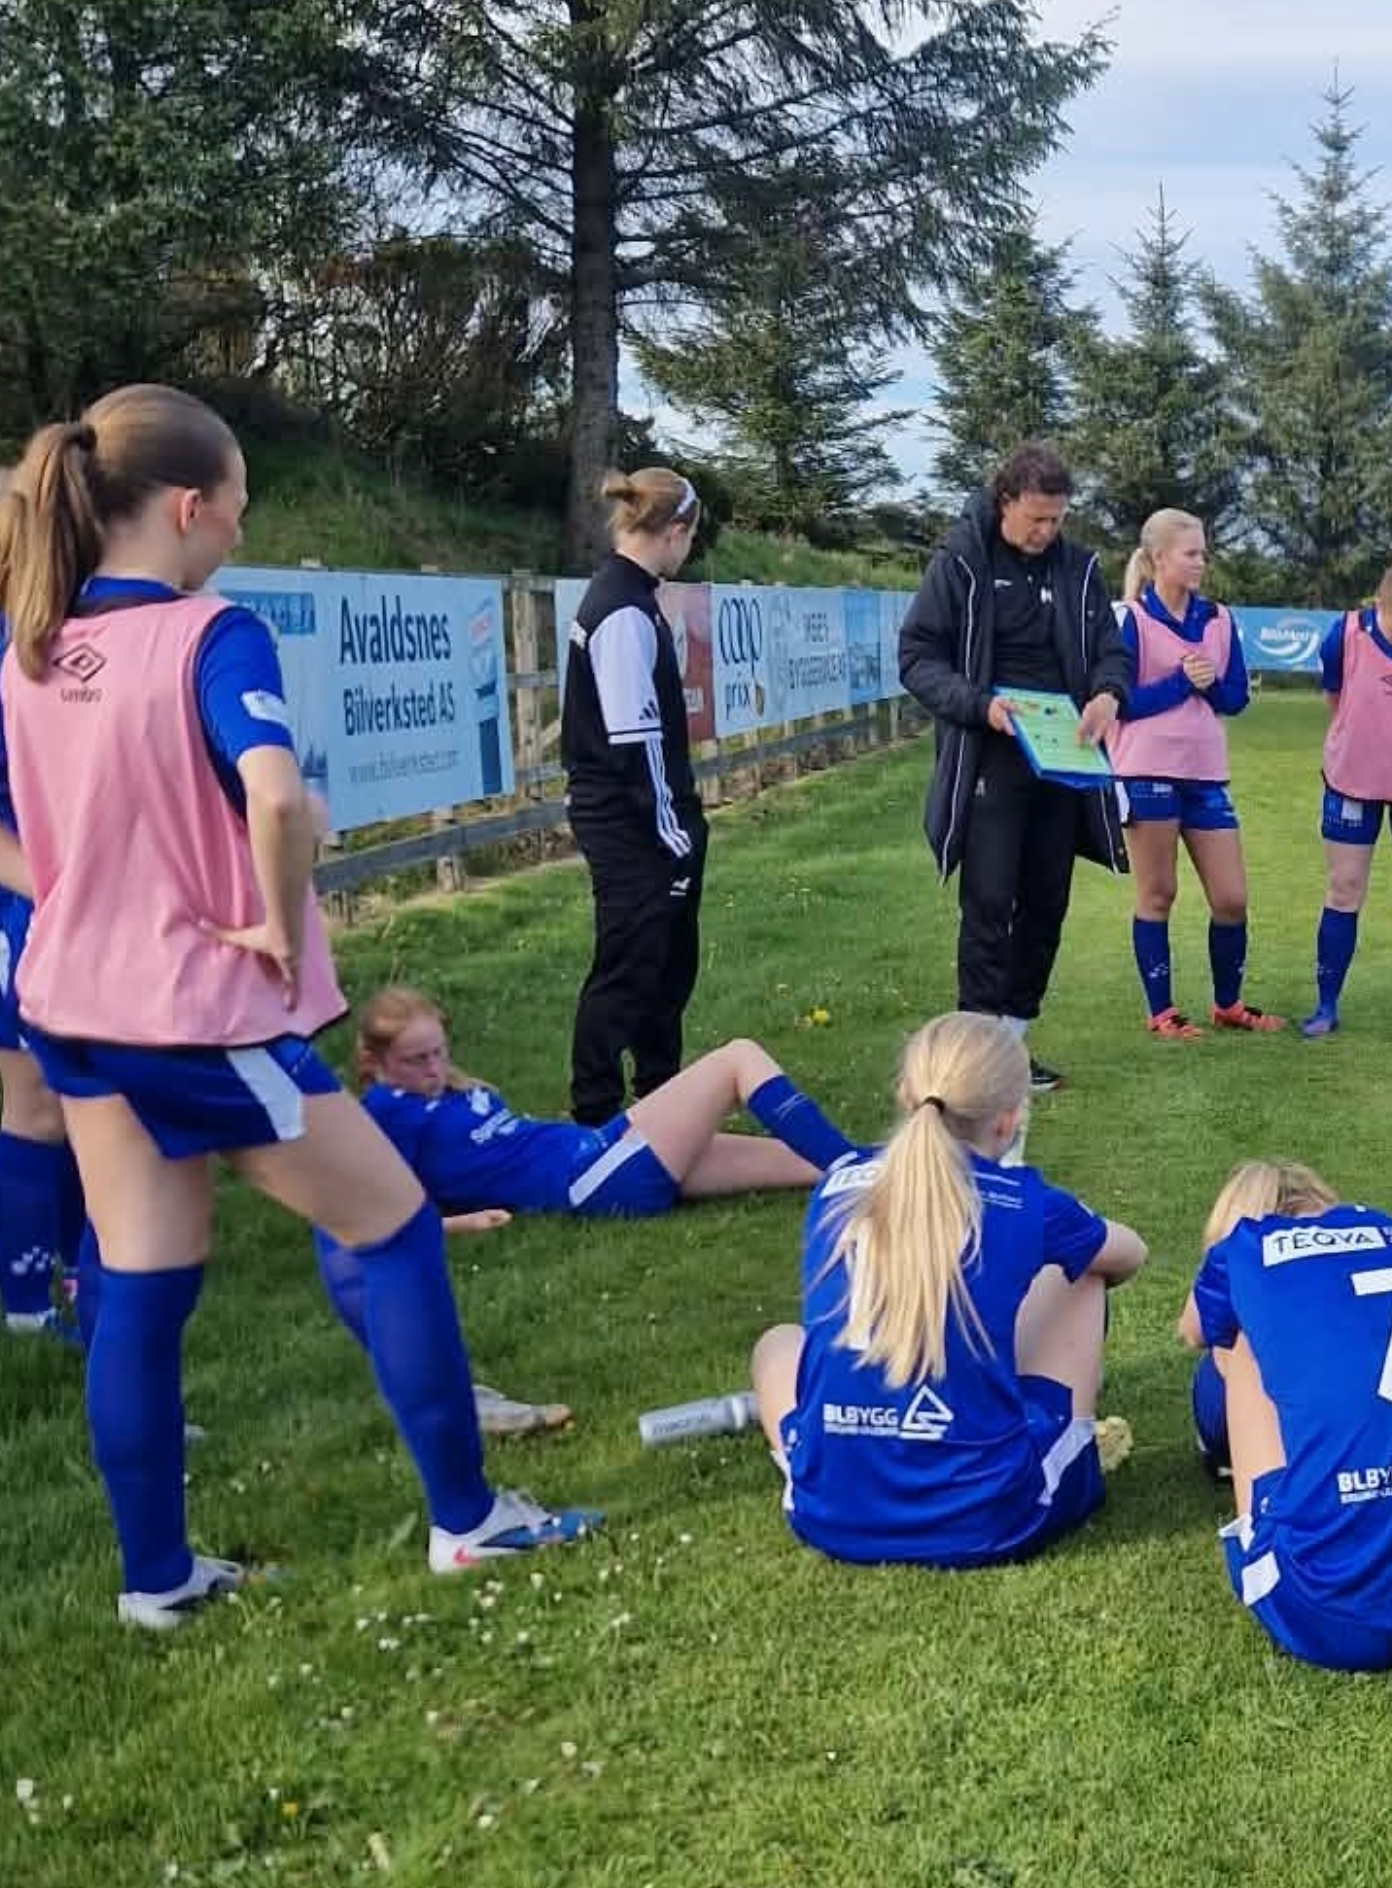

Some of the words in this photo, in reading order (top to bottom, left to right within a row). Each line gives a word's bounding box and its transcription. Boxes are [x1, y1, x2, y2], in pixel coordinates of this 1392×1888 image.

[339, 595, 451, 665] Avaldsnes
[343, 682, 436, 735] Bilverksted
[439, 682, 455, 721] AS
[725, 671, 750, 720] prix
[1272, 1231, 1375, 1255] TEQVA
[823, 1403, 899, 1426] BLBYGG
